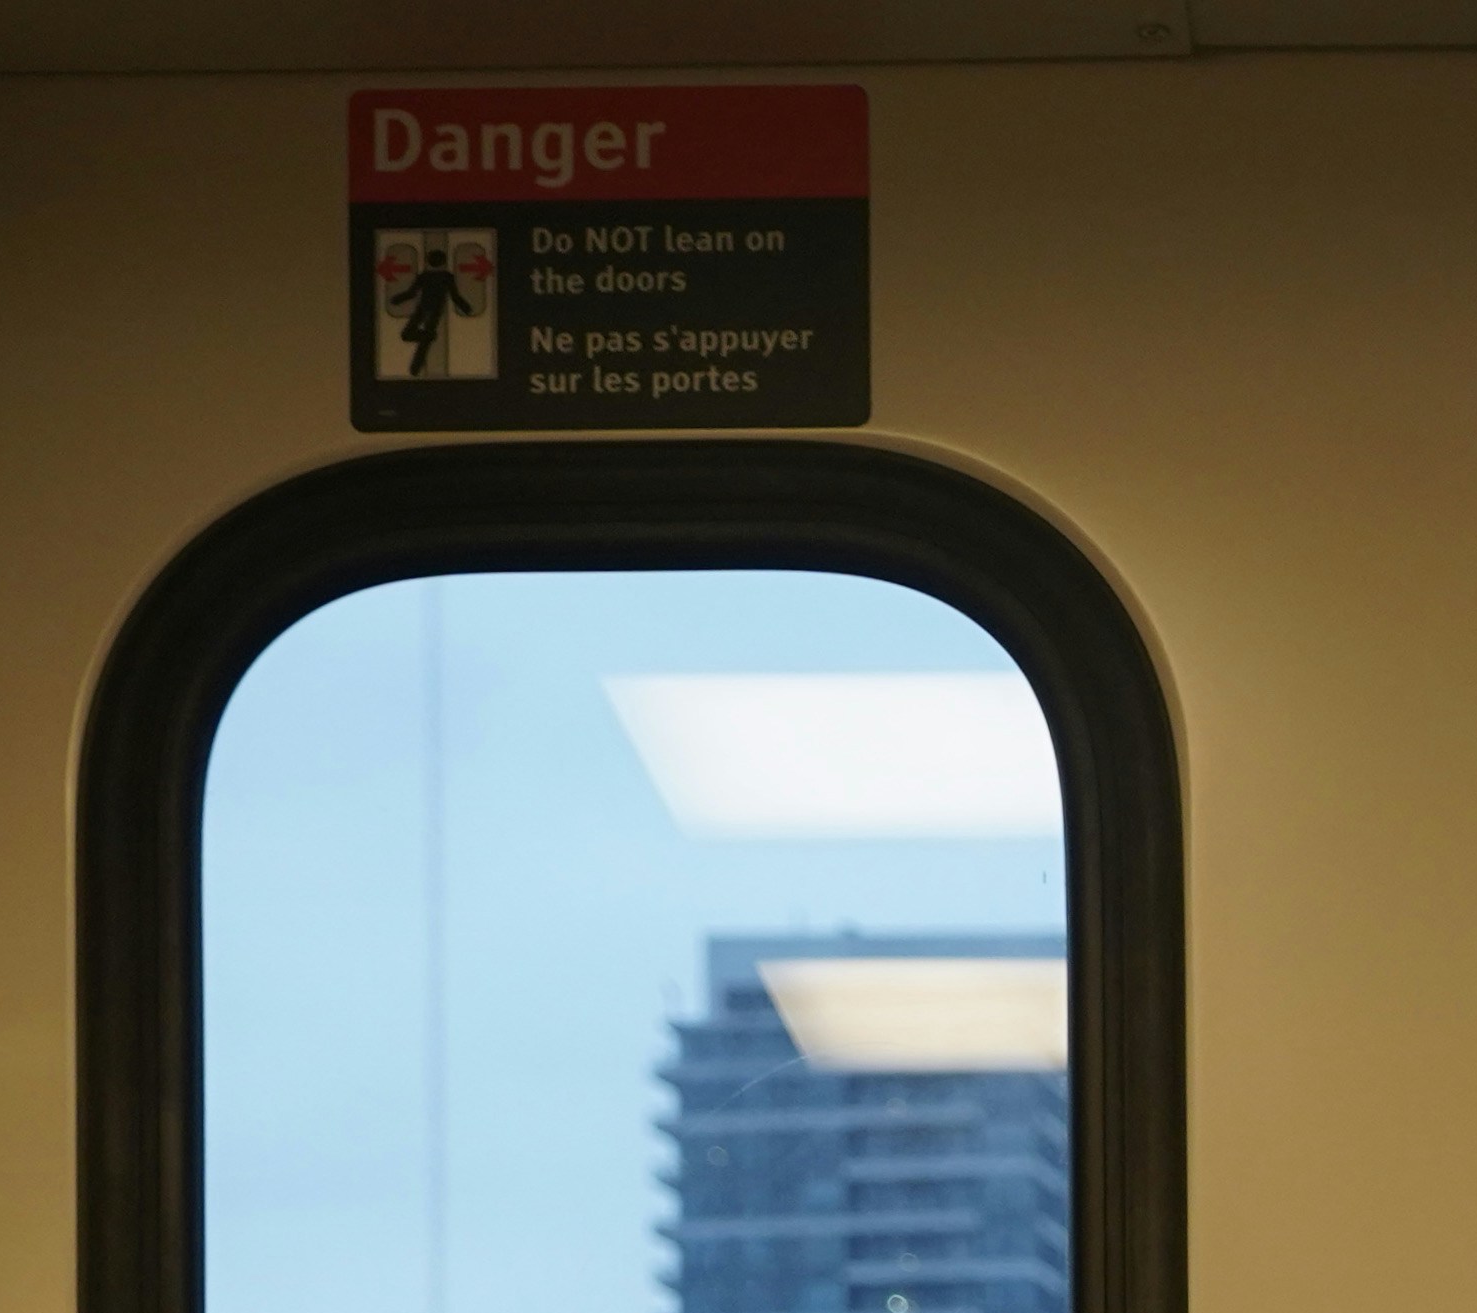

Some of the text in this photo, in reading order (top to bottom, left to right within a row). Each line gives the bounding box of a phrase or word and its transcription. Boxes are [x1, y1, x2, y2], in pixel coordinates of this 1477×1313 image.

[373, 108, 668, 188] Danger
[532, 226, 786, 254] Do NOT lean on
[530, 267, 687, 295] the doors
[530, 324, 813, 359] Ne pas s'appuyer
[530, 366, 759, 398] sur les portes
